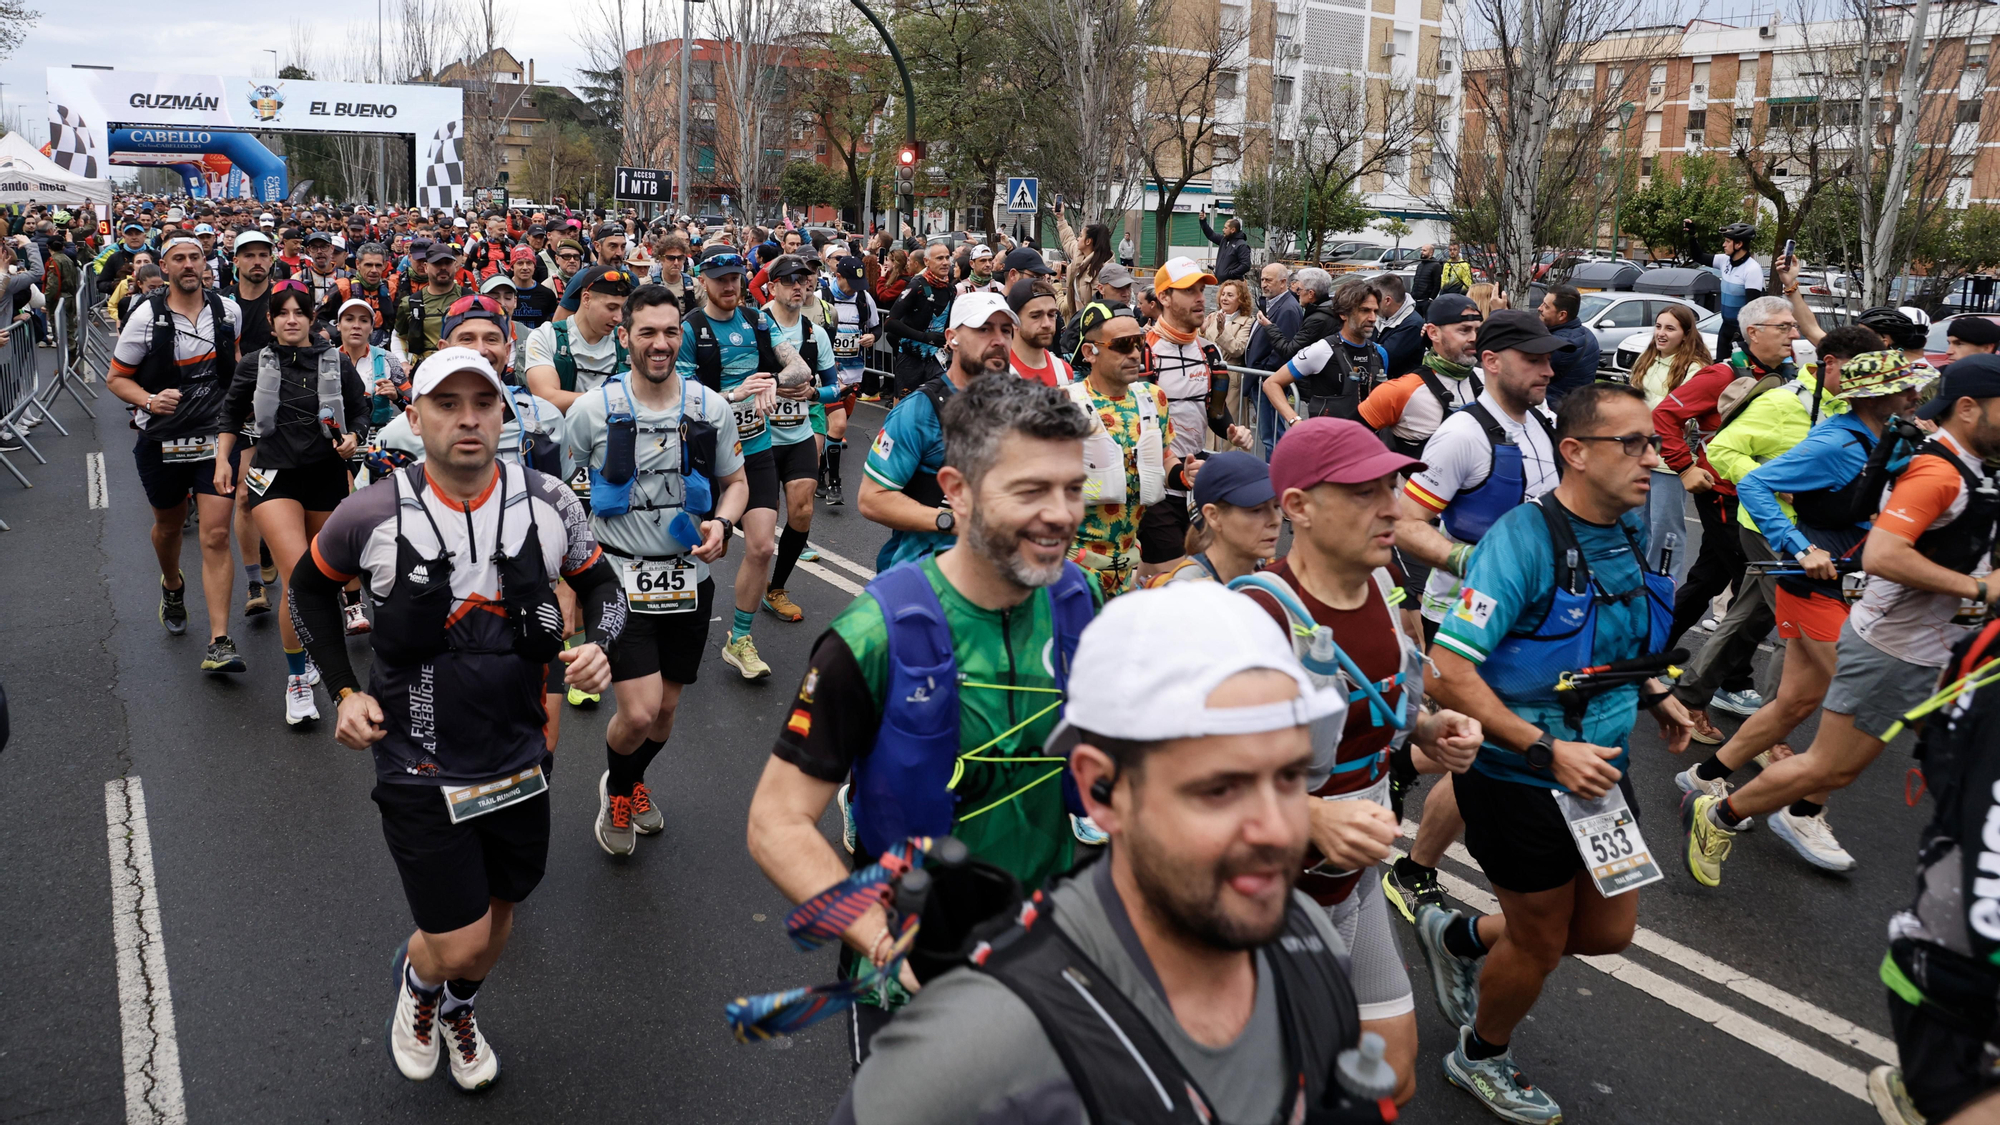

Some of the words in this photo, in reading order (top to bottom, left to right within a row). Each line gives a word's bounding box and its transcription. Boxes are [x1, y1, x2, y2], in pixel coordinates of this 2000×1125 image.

[129, 92, 219, 111] GUZMÁN
[309, 101, 331, 116] EL
[334, 102, 398, 119] BUENO
[130, 130, 211, 144] CABELLO
[633, 170, 656, 179] ACCESO
[631, 179, 658, 196] MTB
[834, 338, 856, 348] 901
[774, 401, 801, 415] 761
[636, 570, 686, 593] 645
[597, 601, 617, 632] FUENTE
[609, 587, 627, 641] ACEBUCHE
[298, 625, 314, 644] CLUB
[408, 684, 425, 738] FUENTE
[420, 664, 437, 740] ACEBUCHE
[477, 797, 497, 808] TRAIL
[1589, 827, 1634, 864] 533
[1471, 1072, 1497, 1102] HOKA
